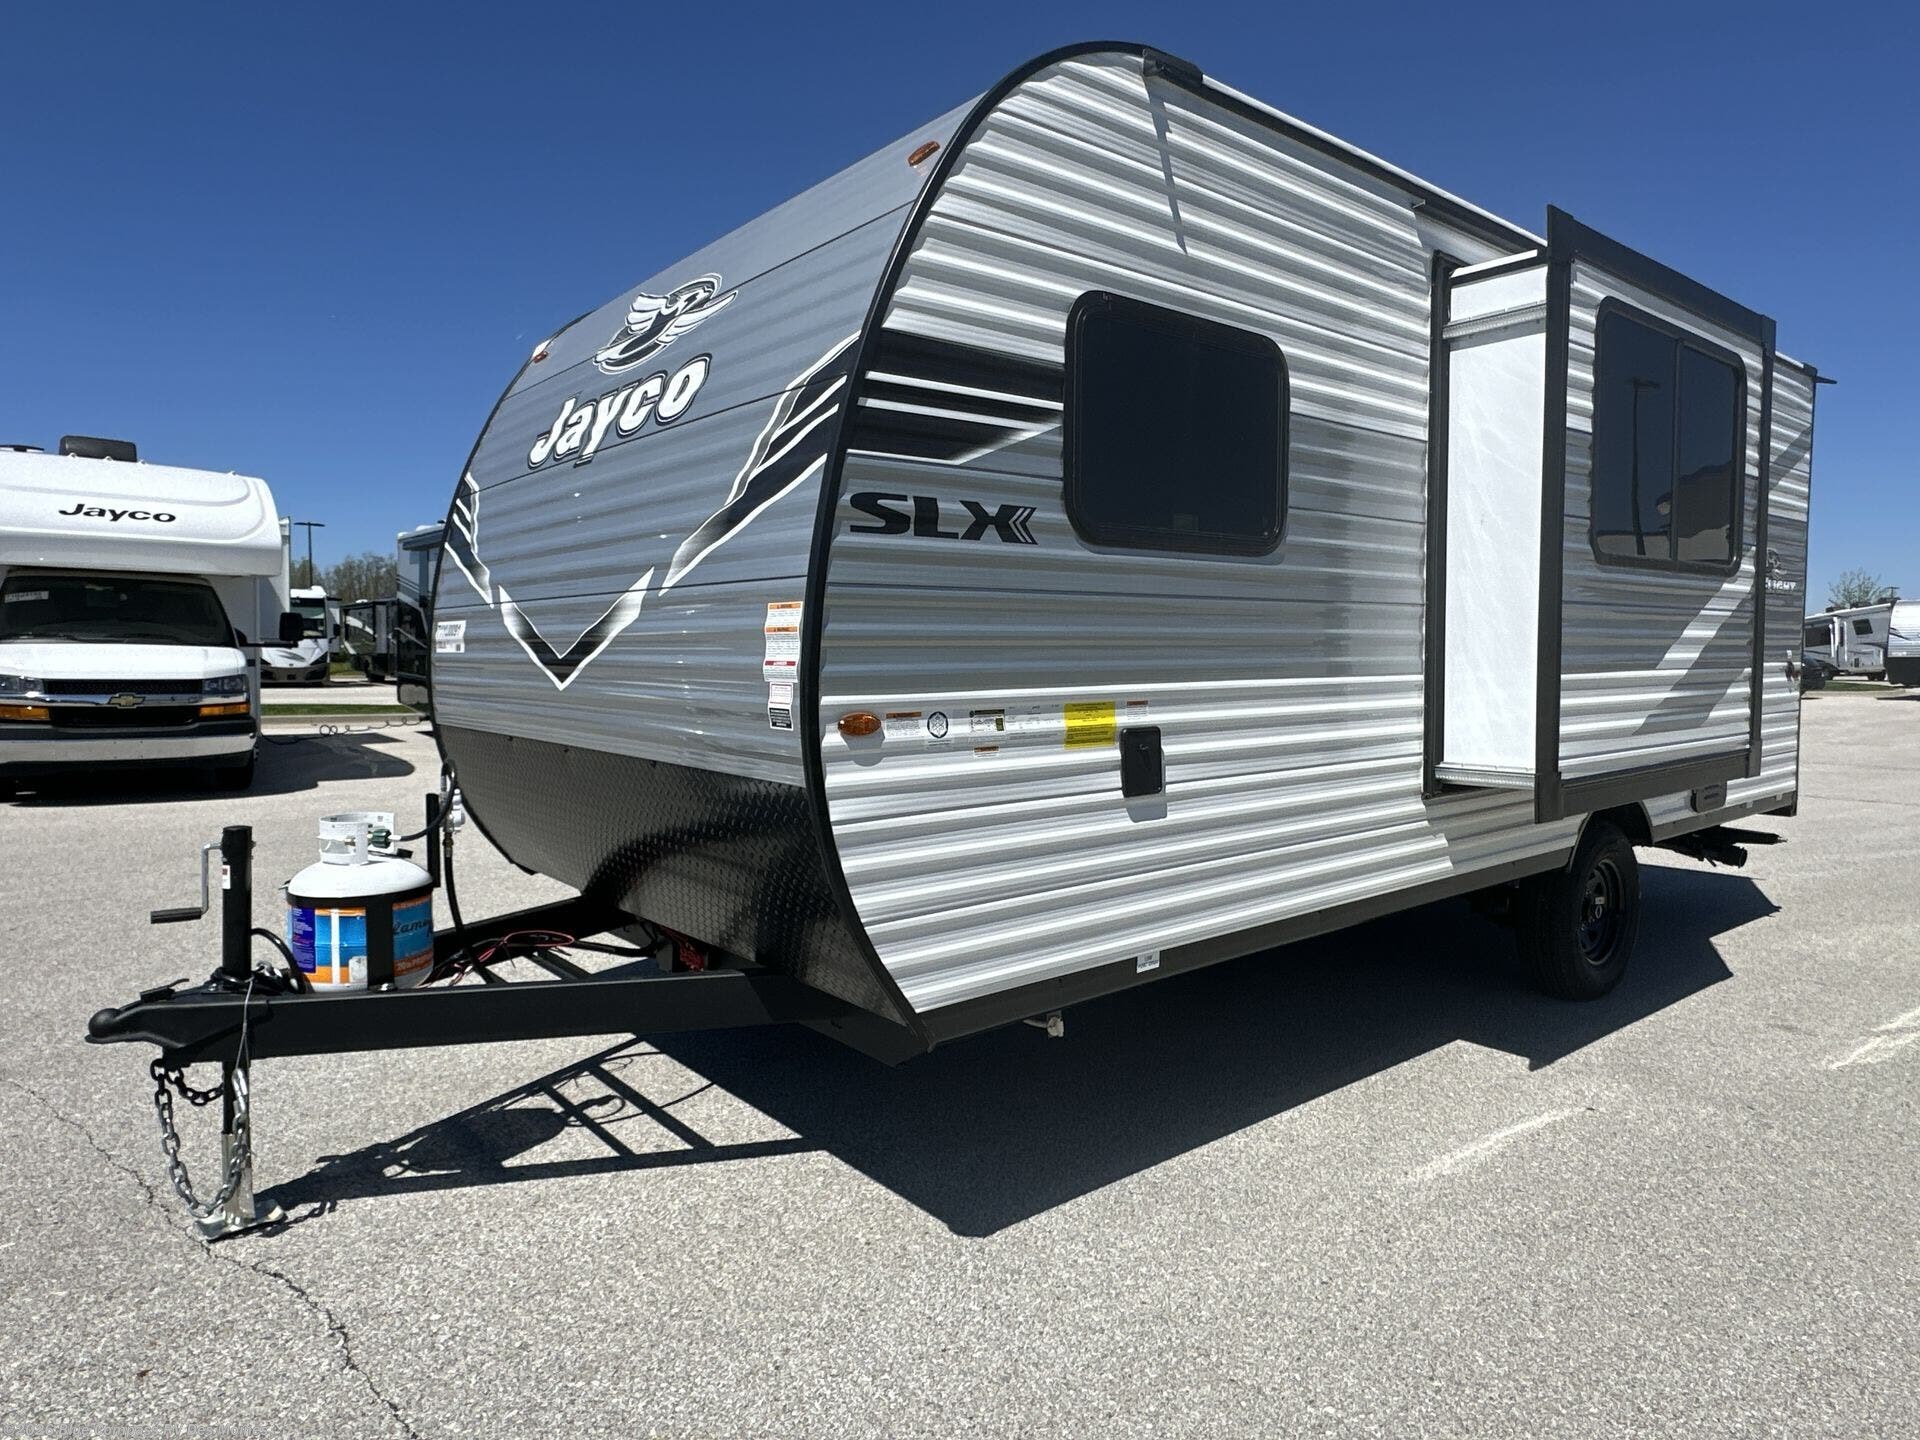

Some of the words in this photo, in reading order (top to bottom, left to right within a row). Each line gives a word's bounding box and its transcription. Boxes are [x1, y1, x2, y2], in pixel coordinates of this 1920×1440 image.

[528, 353, 712, 469] Jayco
[58, 503, 176, 522] Jayco
[850, 492, 1038, 545] SLX
